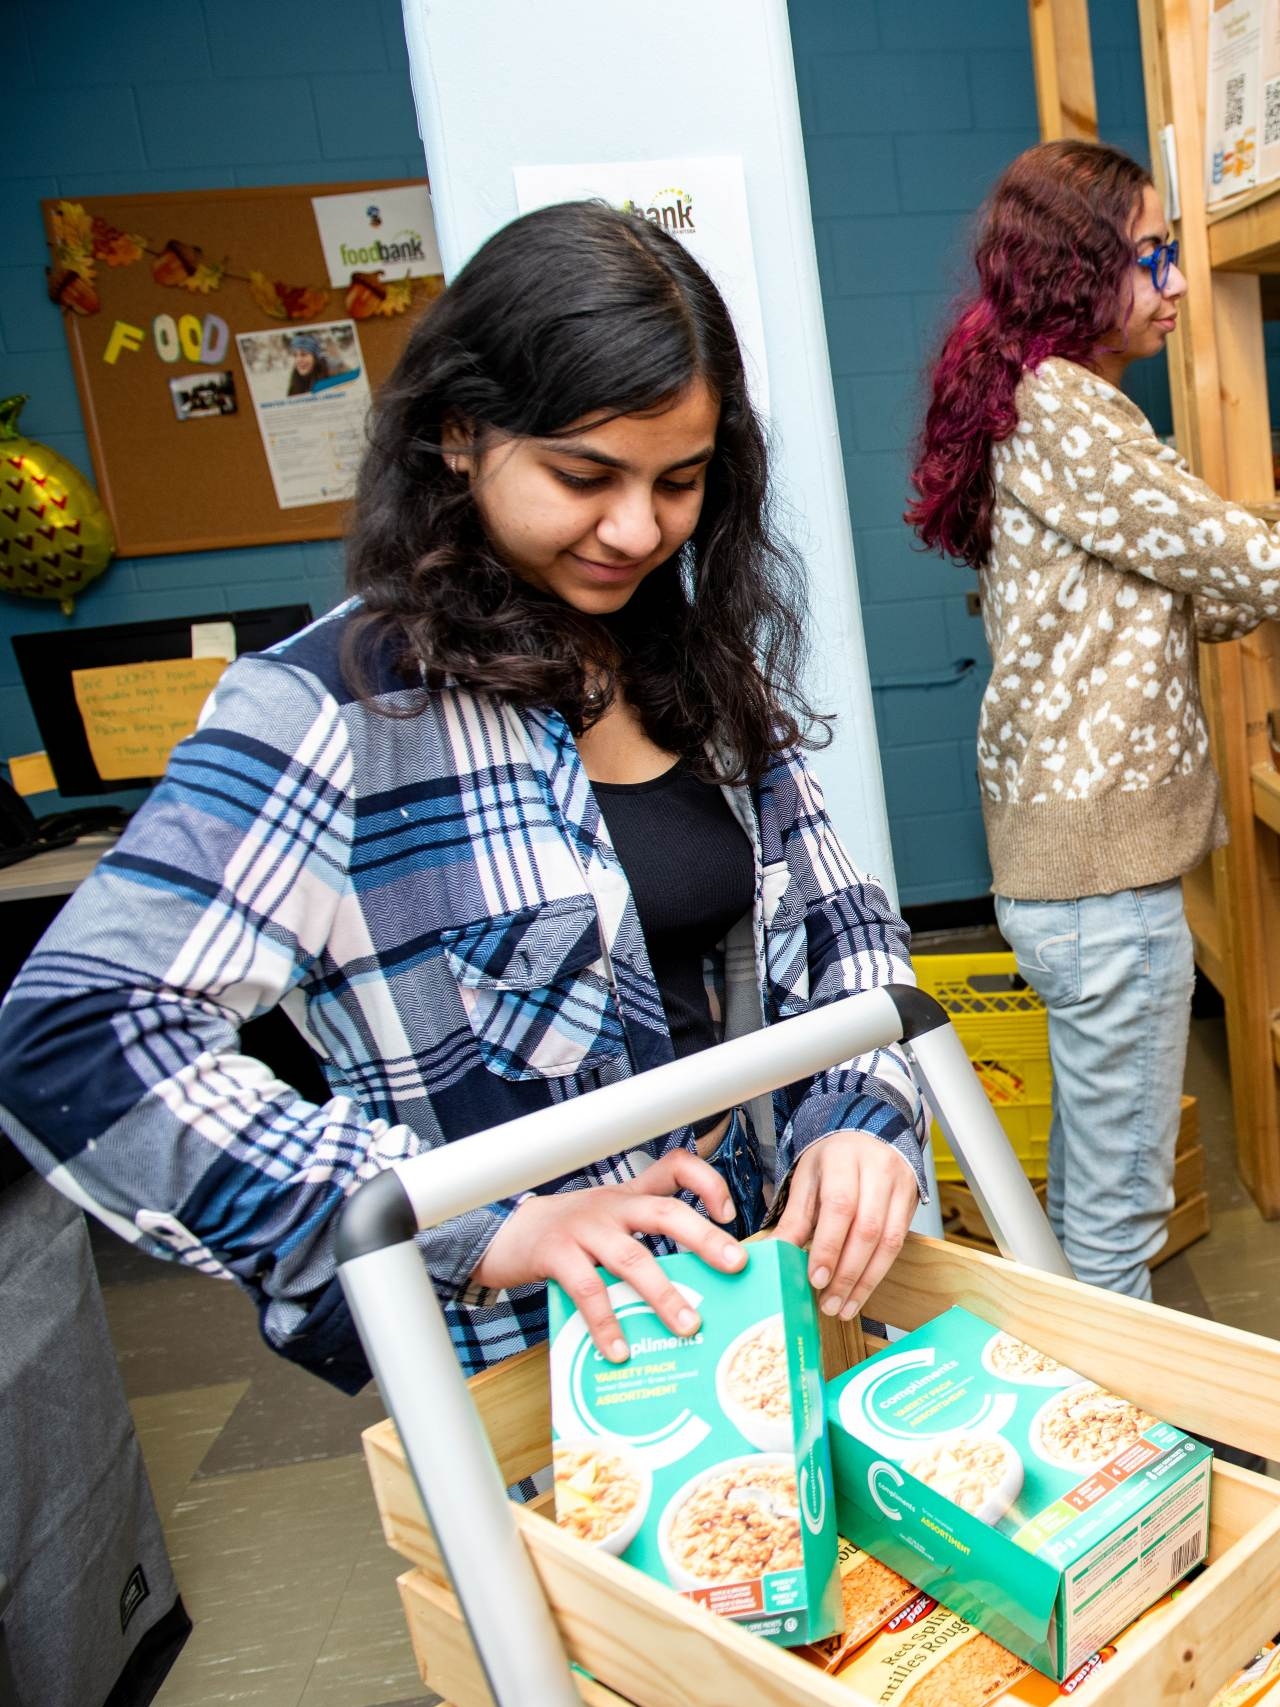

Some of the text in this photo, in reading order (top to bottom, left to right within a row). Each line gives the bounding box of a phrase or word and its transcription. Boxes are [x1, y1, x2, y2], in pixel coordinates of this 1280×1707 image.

[339, 238, 425, 266] foodbank
[104, 314, 229, 365] FOOD
[880, 1360, 959, 1409] compliments
[878, 1481, 916, 1513] compliments
[920, 1516, 971, 1556] ASSORTIMENT
[881, 1611, 952, 1666] Red Split
[880, 1654, 928, 1703] ntilles
